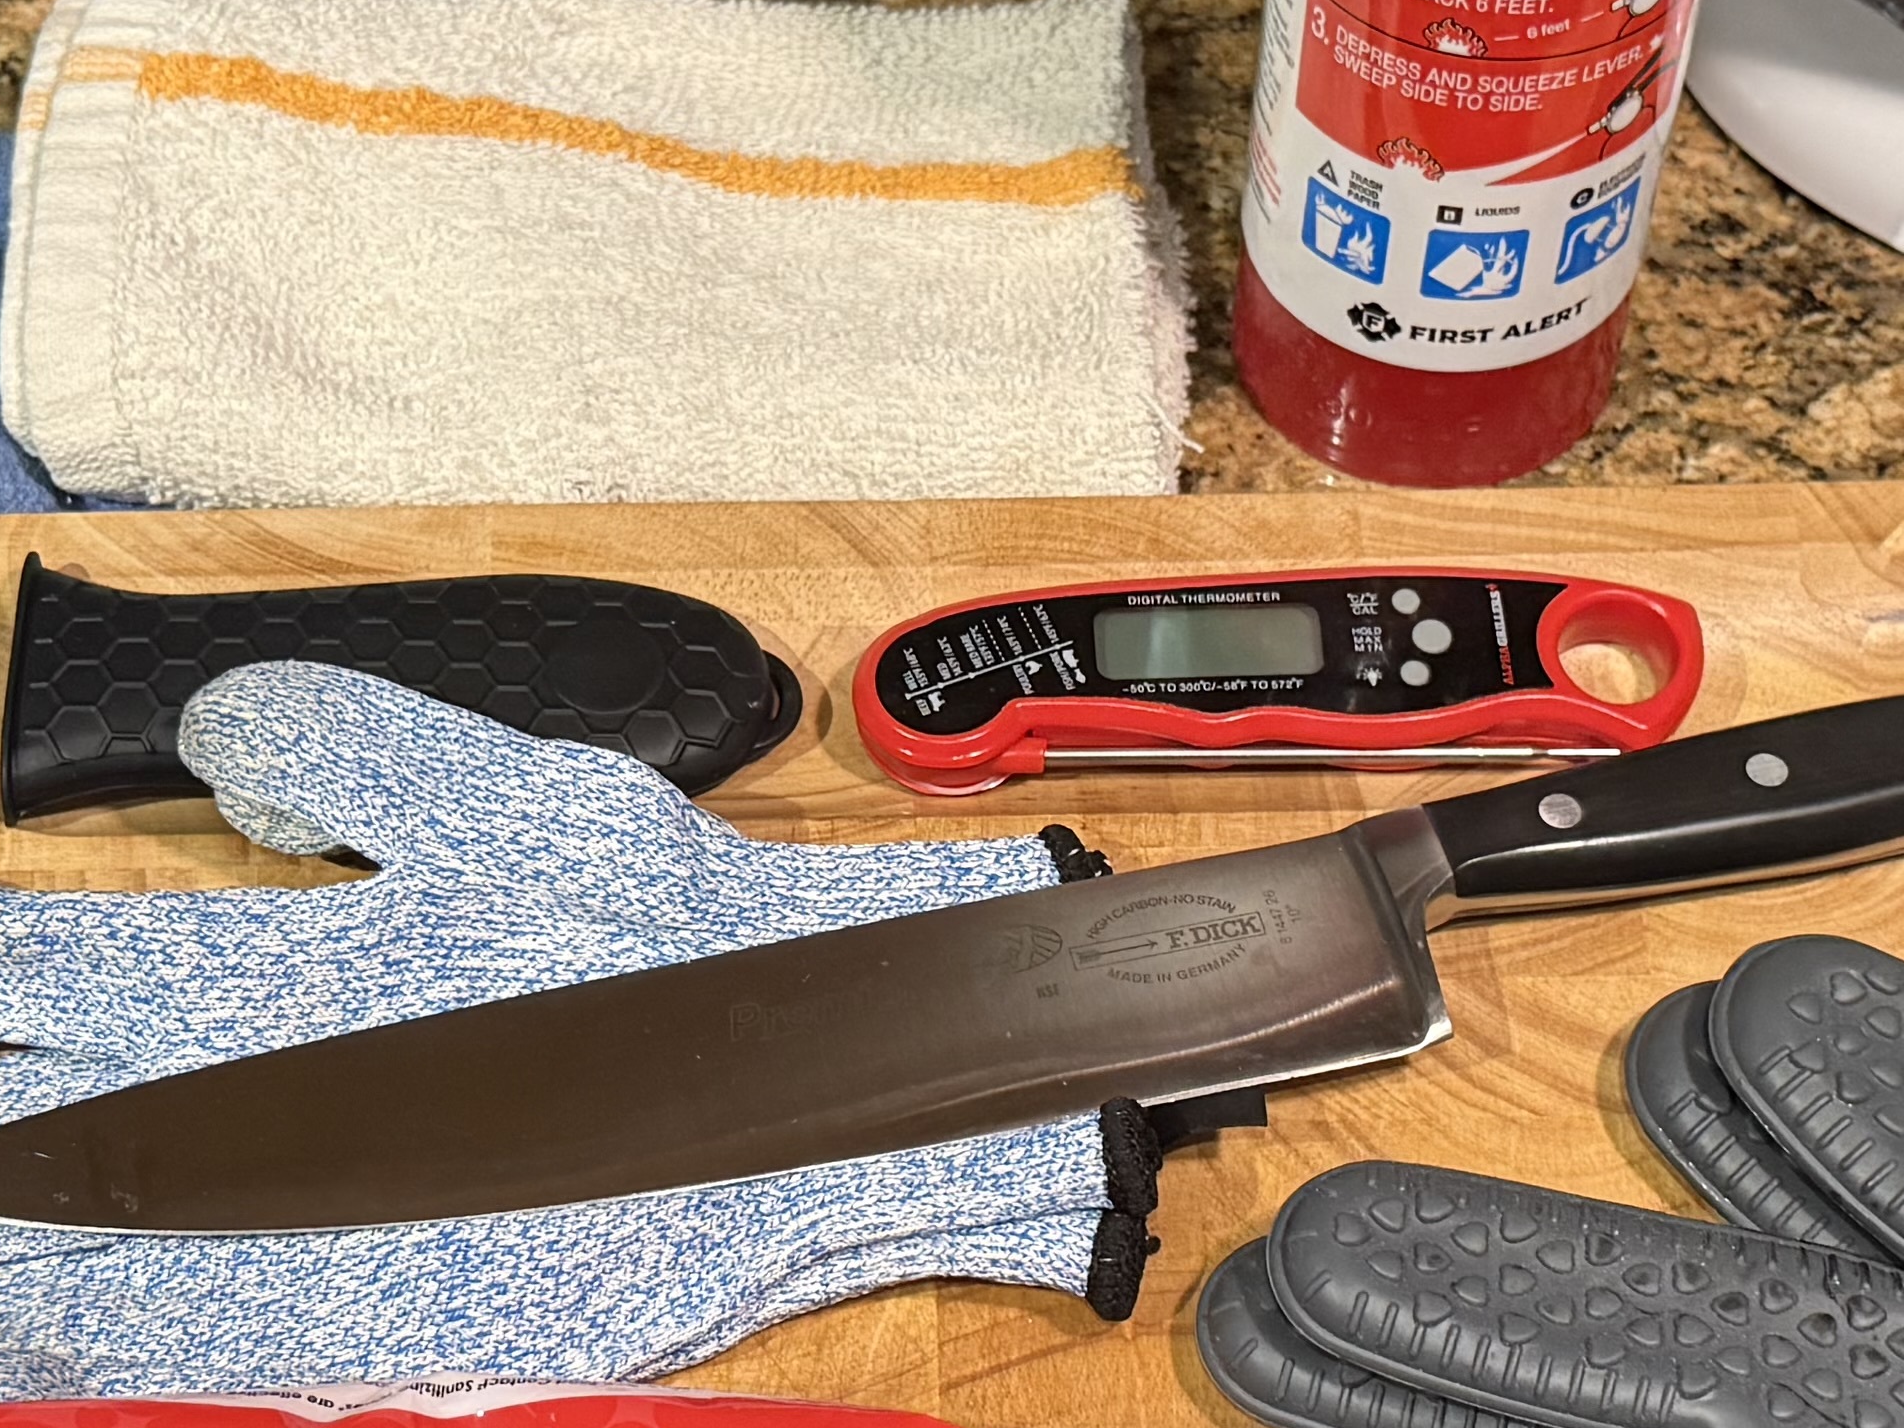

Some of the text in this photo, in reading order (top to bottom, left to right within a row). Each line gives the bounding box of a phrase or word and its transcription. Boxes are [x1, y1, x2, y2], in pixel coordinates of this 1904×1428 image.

[1310, 6, 1644, 94] 3. DEPRESS AND SQUEEZE LEVER.
[1333, 48, 1544, 112] SWEEP SIDE TO SIDE.
[1409, 295, 1593, 344] FIRST ALERT
[1127, 591, 1281, 606] DIGITAL THERMOMETER
[1352, 604, 1379, 616] CAL
[1351, 626, 1382, 637] HOLD
[1352, 635, 1382, 645] MAX
[1353, 643, 1384, 653] MIN
[1159, 681, 1176, 692] TO
[1251, 679, 1268, 690] TO
[1107, 943, 1247, 984] MADE IN GERMANY
